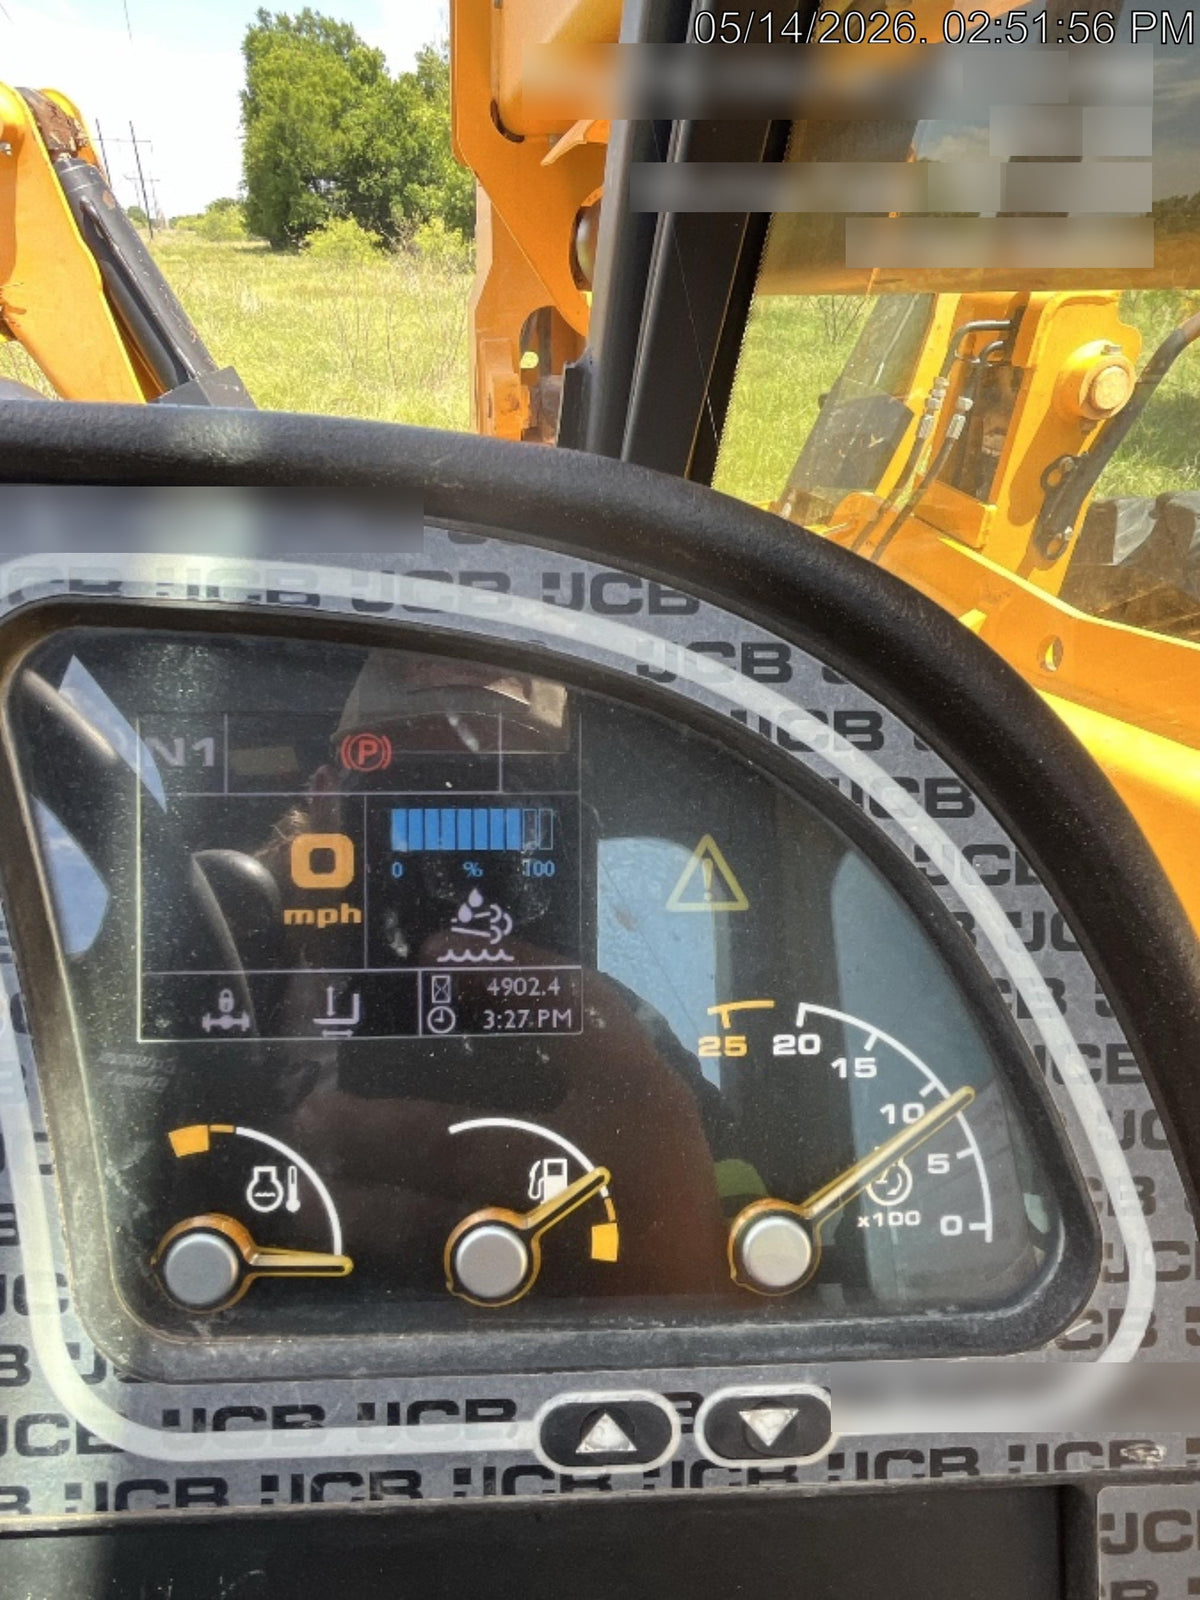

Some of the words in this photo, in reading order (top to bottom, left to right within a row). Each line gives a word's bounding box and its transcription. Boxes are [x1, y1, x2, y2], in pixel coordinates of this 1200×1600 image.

[542, 572, 699, 615] JCB
[391, 861, 403, 878] 0
[522, 860, 555, 878] 100
[284, 903, 362, 929] mph
[486, 976, 561, 997] 4902.4
[483, 1009, 530, 1030] 3:27
[537, 1008, 572, 1029] PM
[698, 1035, 748, 1057] 25
[773, 1034, 821, 1056] 20
[831, 1057, 878, 1078] 15
[880, 1103, 925, 1124] 10
[927, 1153, 950, 1174] 5
[857, 1211, 921, 1228] x100
[940, 1215, 964, 1237] 0
